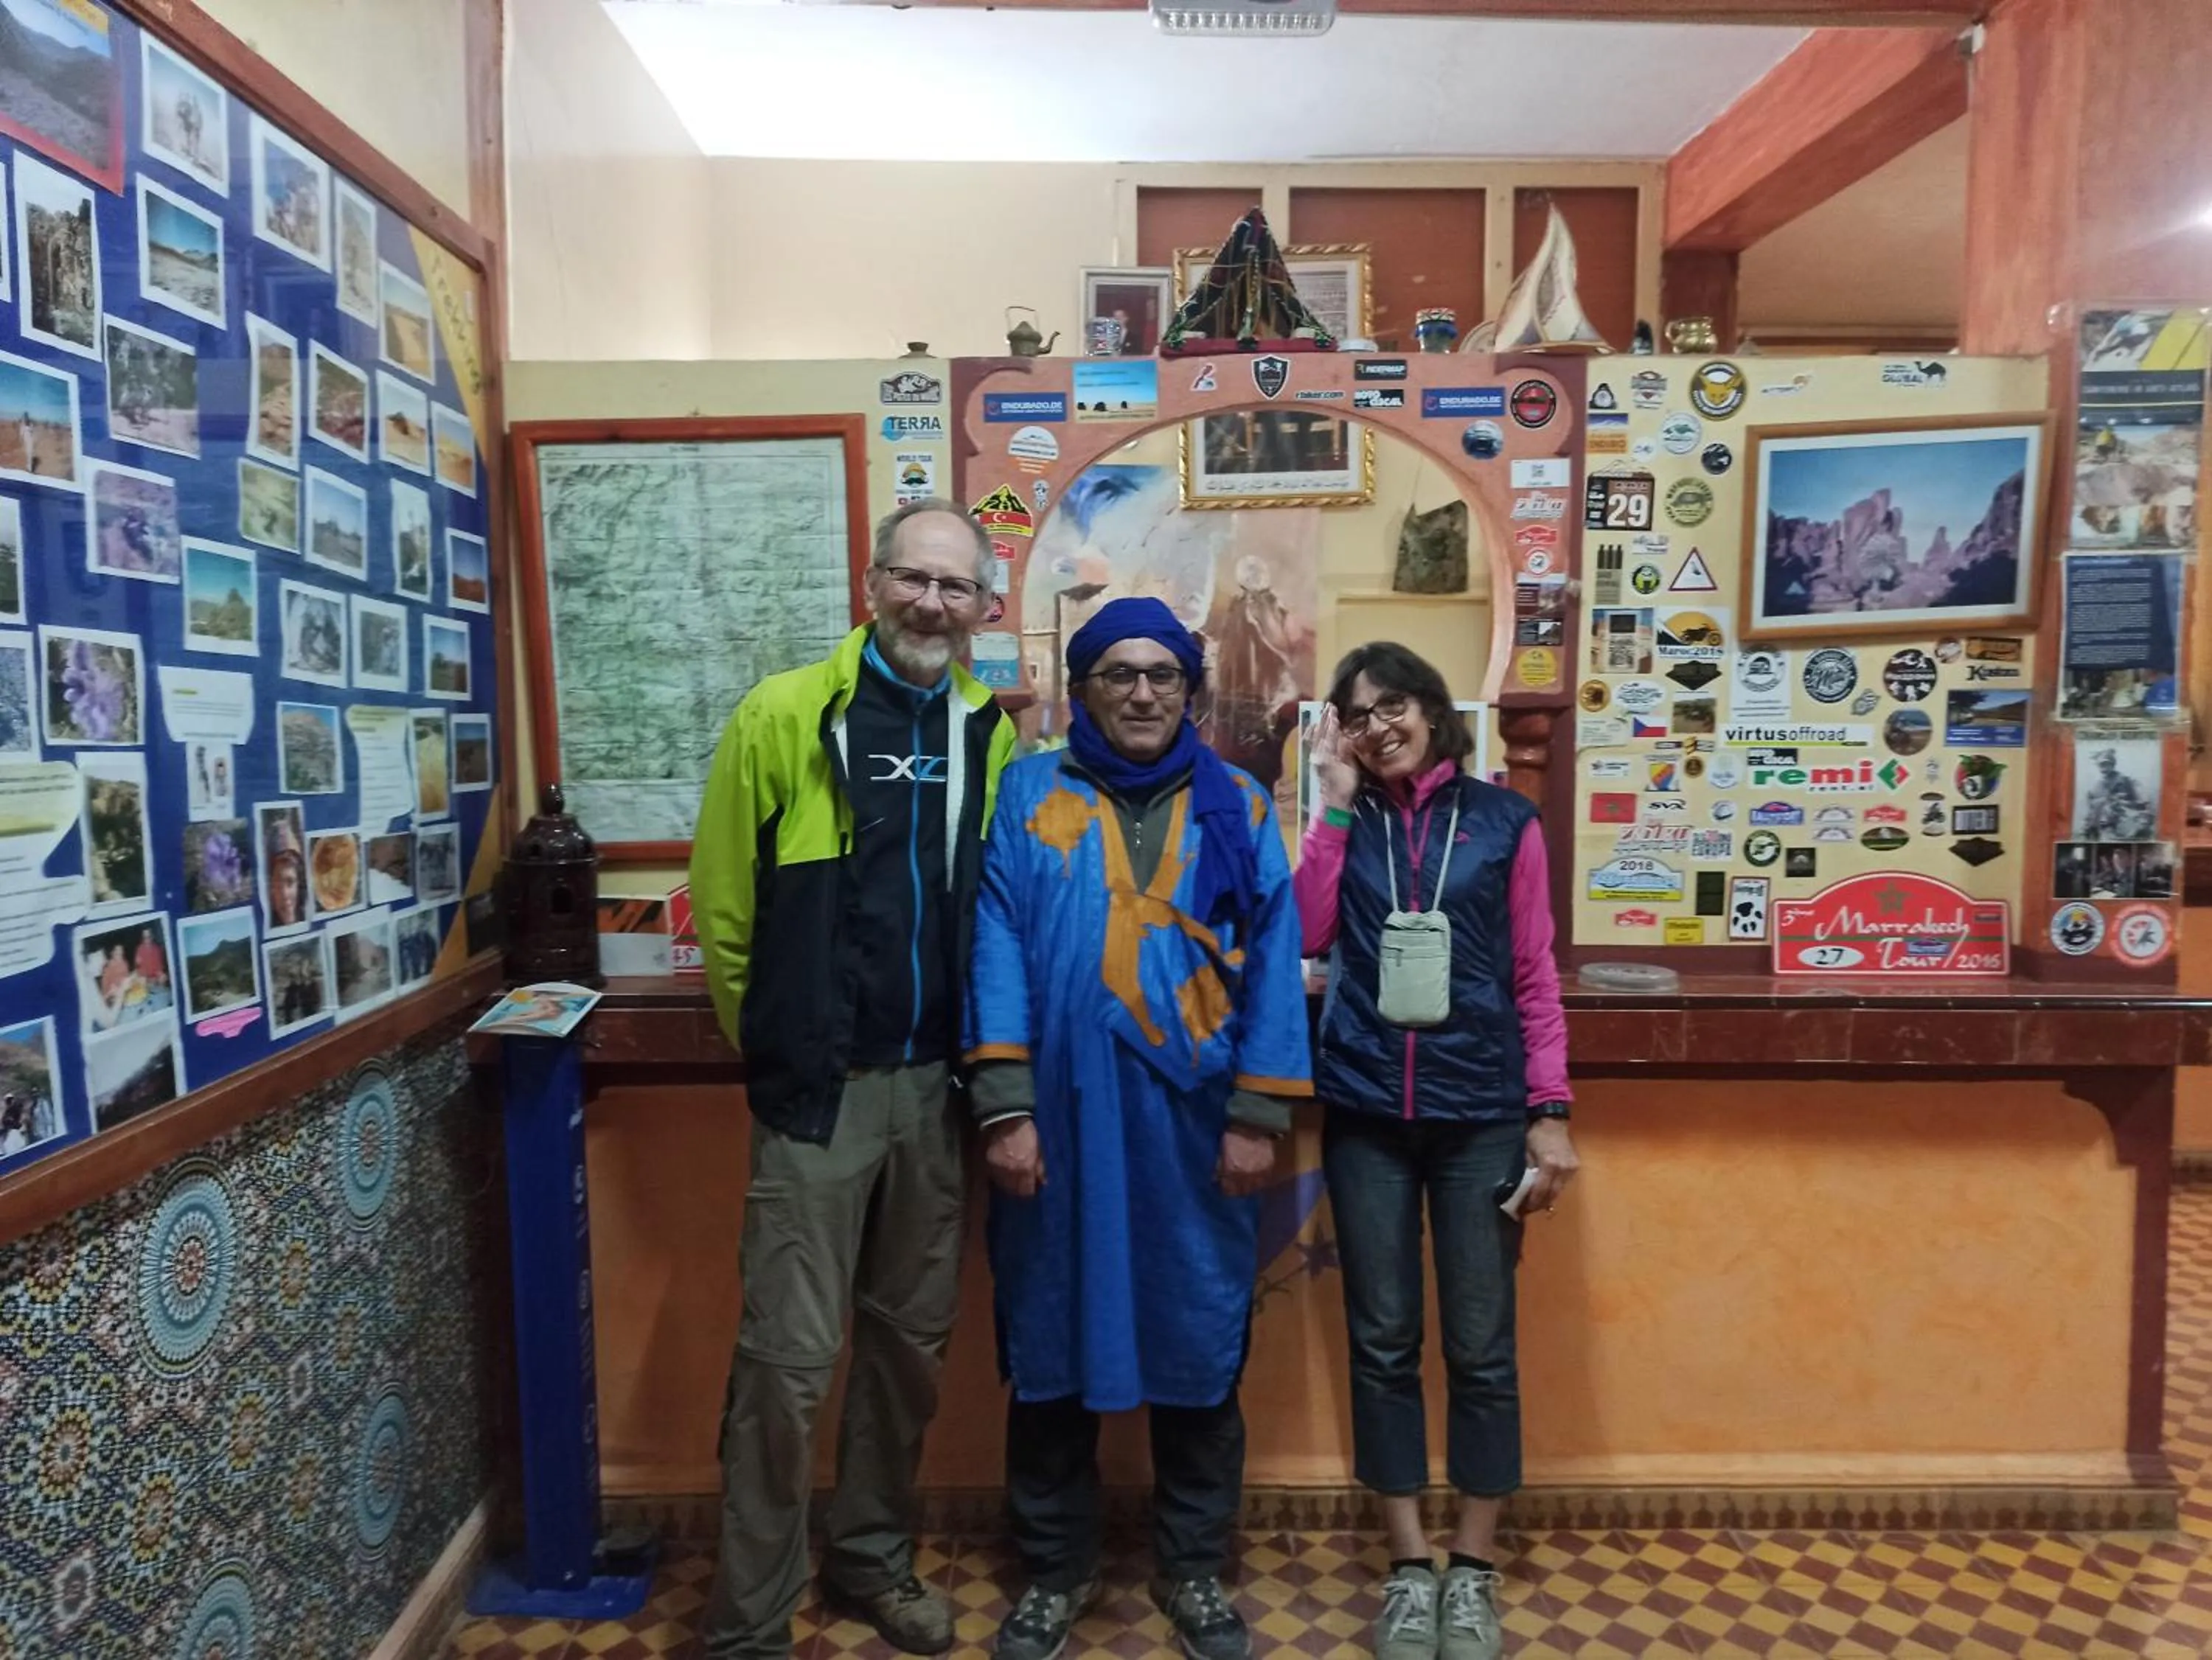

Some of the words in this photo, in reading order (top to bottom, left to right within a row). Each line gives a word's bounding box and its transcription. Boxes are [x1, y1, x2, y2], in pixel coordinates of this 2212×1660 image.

[1607, 493, 1649, 527] 29
[1725, 727, 1847, 741] virtusoffroad
[1753, 760, 1874, 785] remi
[1619, 860, 1654, 871] 2018
[1814, 905, 1971, 968] Marrakech
[1815, 947, 1846, 965] 27
[1877, 937, 1943, 969] Tour
